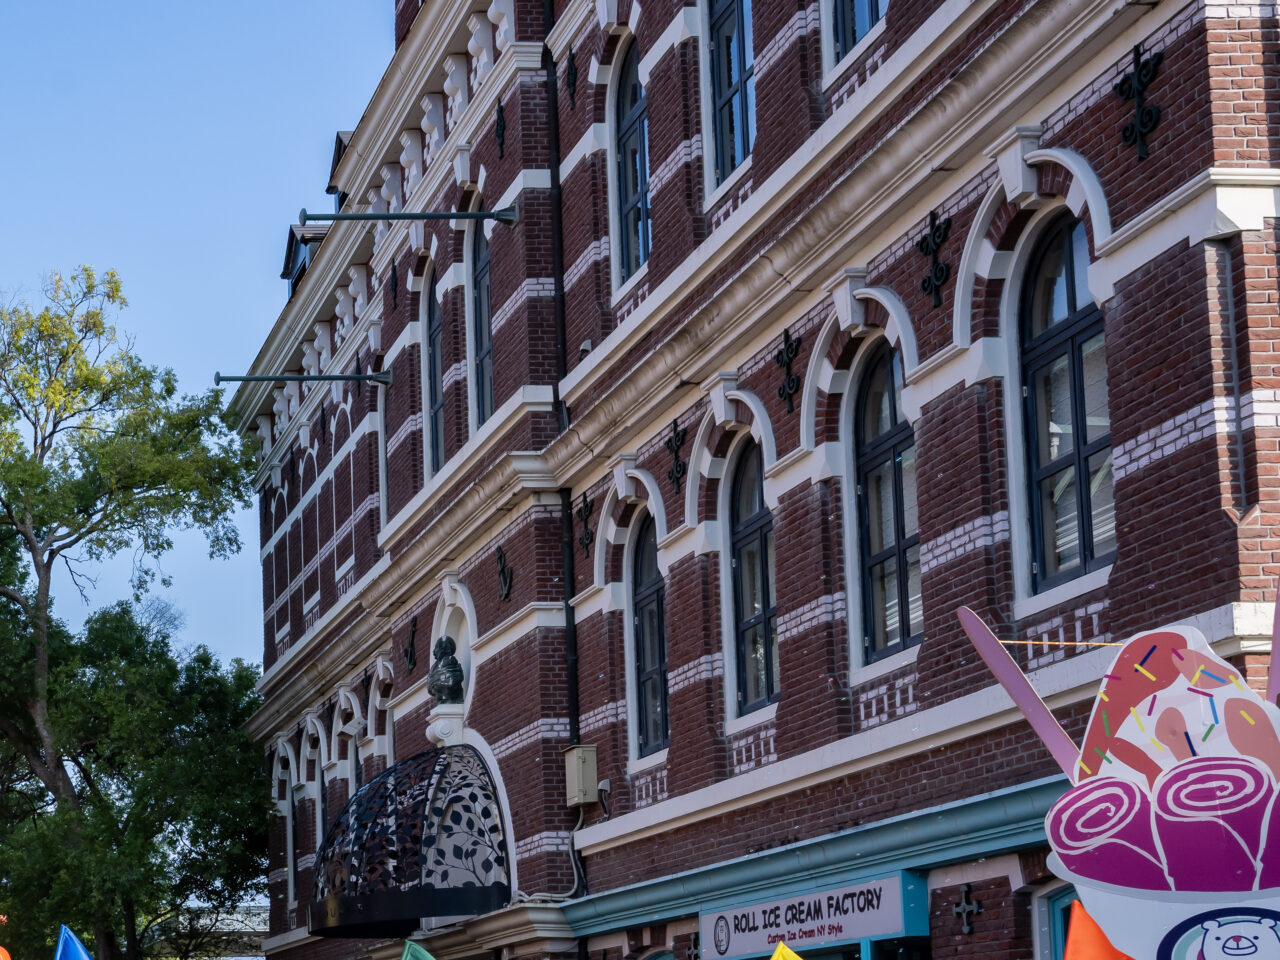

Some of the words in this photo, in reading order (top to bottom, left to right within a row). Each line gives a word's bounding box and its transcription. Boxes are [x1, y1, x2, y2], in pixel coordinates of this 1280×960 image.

[733, 912, 759, 934] ROLL
[762, 906, 781, 929] ICE
[784, 899, 823, 925] CREAM
[827, 886, 883, 919] FACTORY
[787, 930, 797, 941] Ice
[798, 927, 816, 939] Cream
[817, 926, 826, 937] NY
[827, 923, 843, 936] Style
